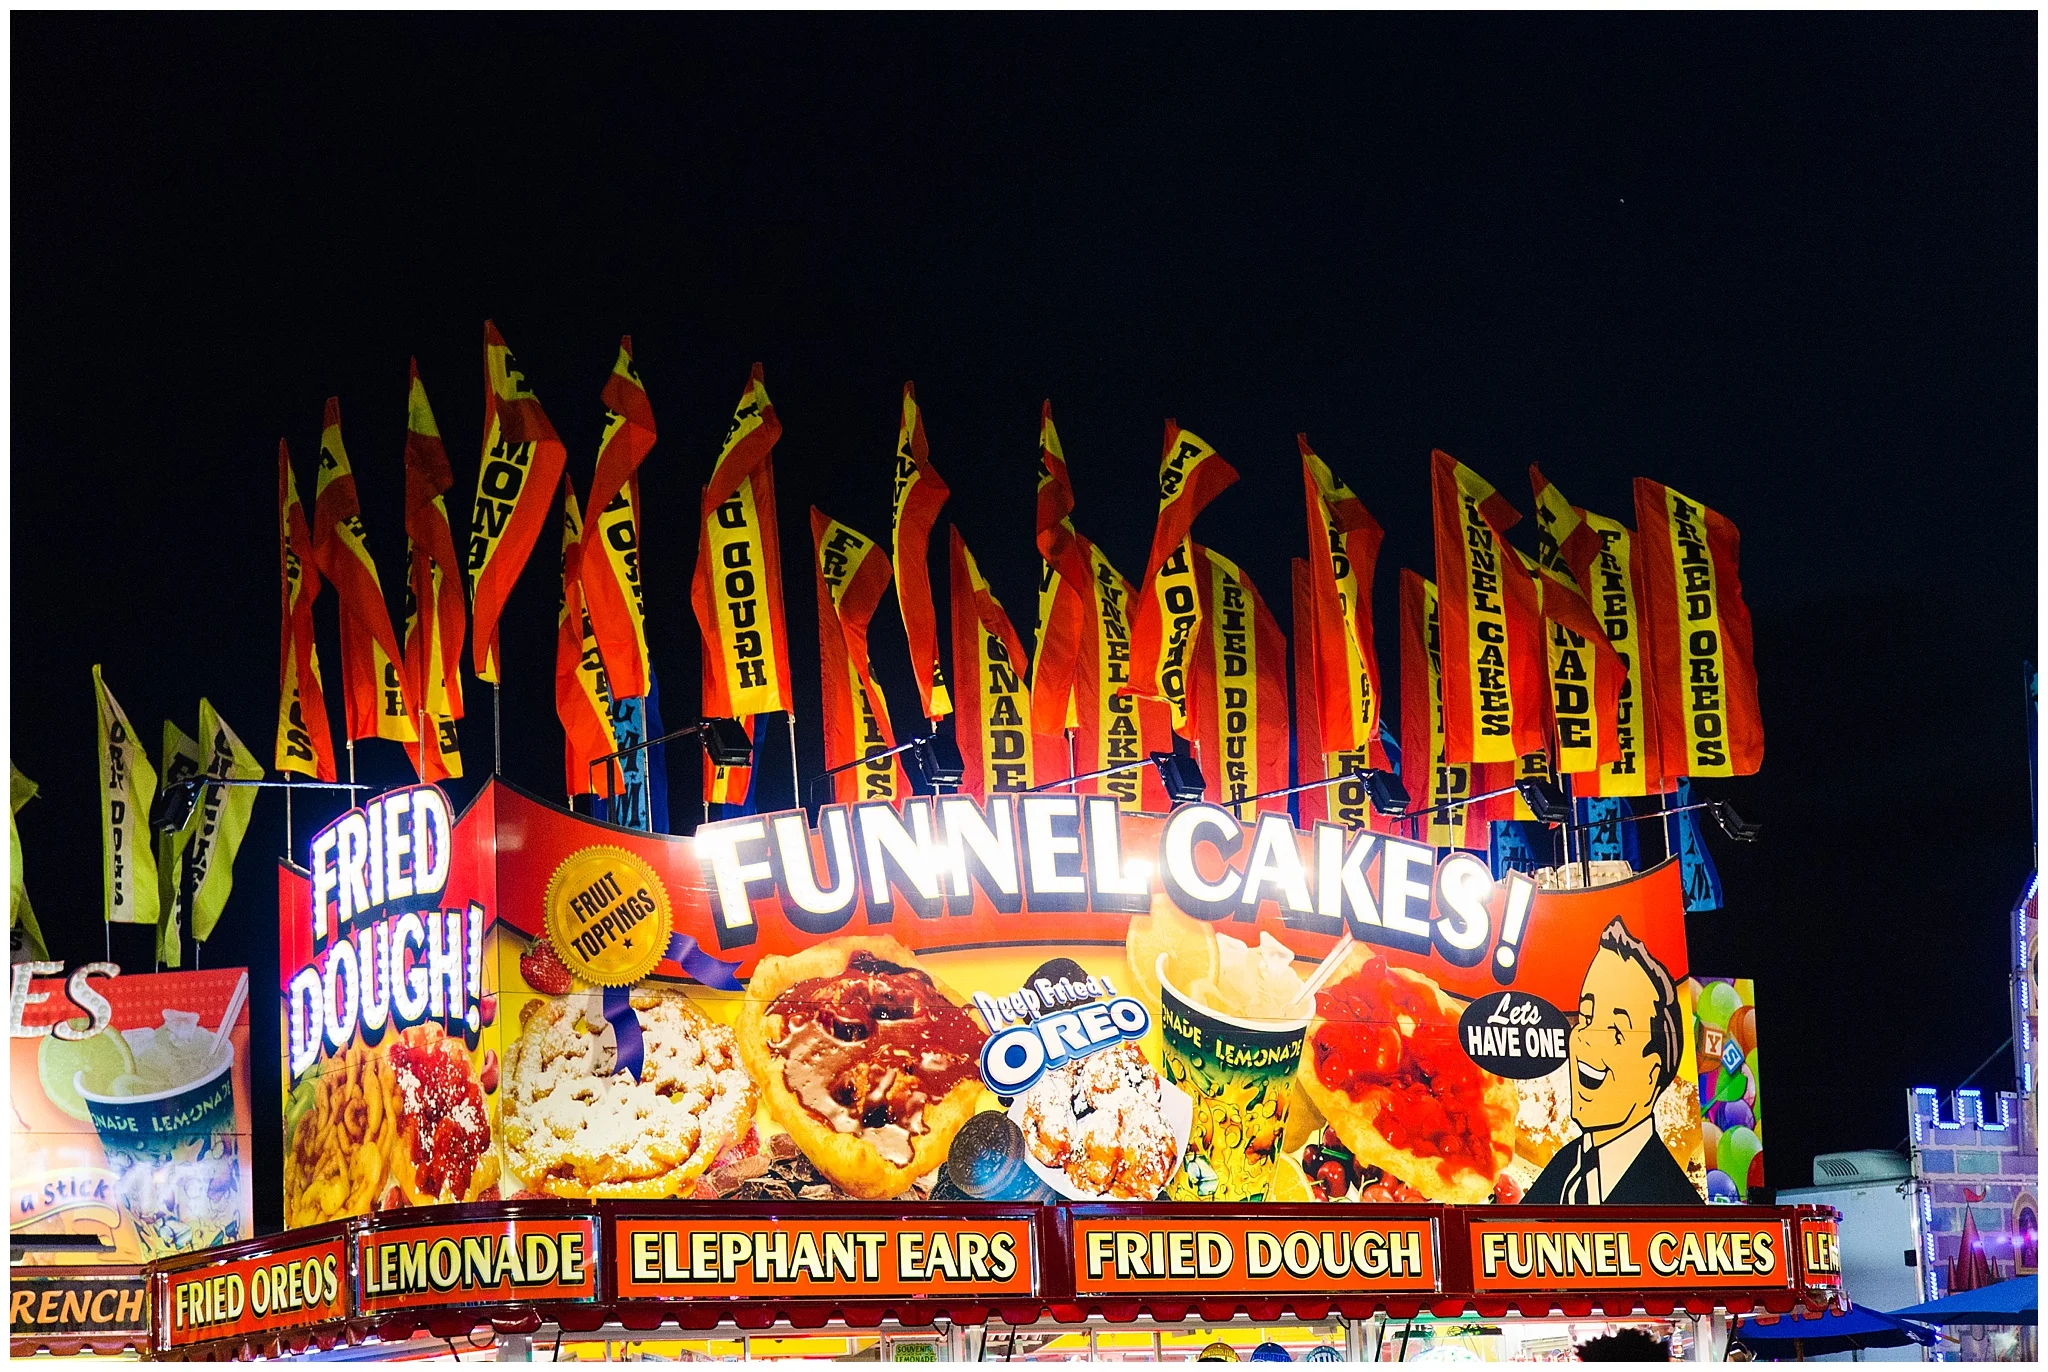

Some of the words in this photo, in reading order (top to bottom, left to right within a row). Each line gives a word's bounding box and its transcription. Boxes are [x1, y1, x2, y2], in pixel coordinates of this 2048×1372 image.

[1597, 529, 1630, 641] FRIED
[1672, 495, 1712, 622] FRIED
[1476, 620, 1512, 738] CAKES
[1688, 629, 1727, 767] OREOS
[1106, 694, 1138, 803] CAKES
[312, 789, 451, 940] FRIED
[569, 871, 622, 924] FRUIT
[697, 798, 1150, 929] FUNNEL
[1165, 806, 1534, 968] CAKES!
[571, 888, 656, 963] TOPPINGS
[288, 904, 484, 1079] DOUGH!
[973, 988, 1041, 1034] Deep
[1487, 992, 1542, 1026] Lets
[984, 1000, 1147, 1089] OREO
[1467, 1026, 1522, 1057] HAVE
[1526, 1027, 1567, 1058] ONE
[20, 1194, 34, 1213] a
[43, 1177, 111, 1206] Stick
[176, 1277, 245, 1328] FRIED
[250, 1254, 339, 1315] OREOS
[365, 1232, 584, 1294] LEMONADE
[632, 1231, 887, 1283] ELEPHANT
[898, 1231, 1018, 1283] EARS
[1086, 1231, 1234, 1279] FRIED
[1247, 1231, 1422, 1279] DOUGH
[1482, 1231, 1643, 1277] FUNNEL
[1648, 1231, 1776, 1277] CAKES
[10, 1288, 142, 1324] RENCH
